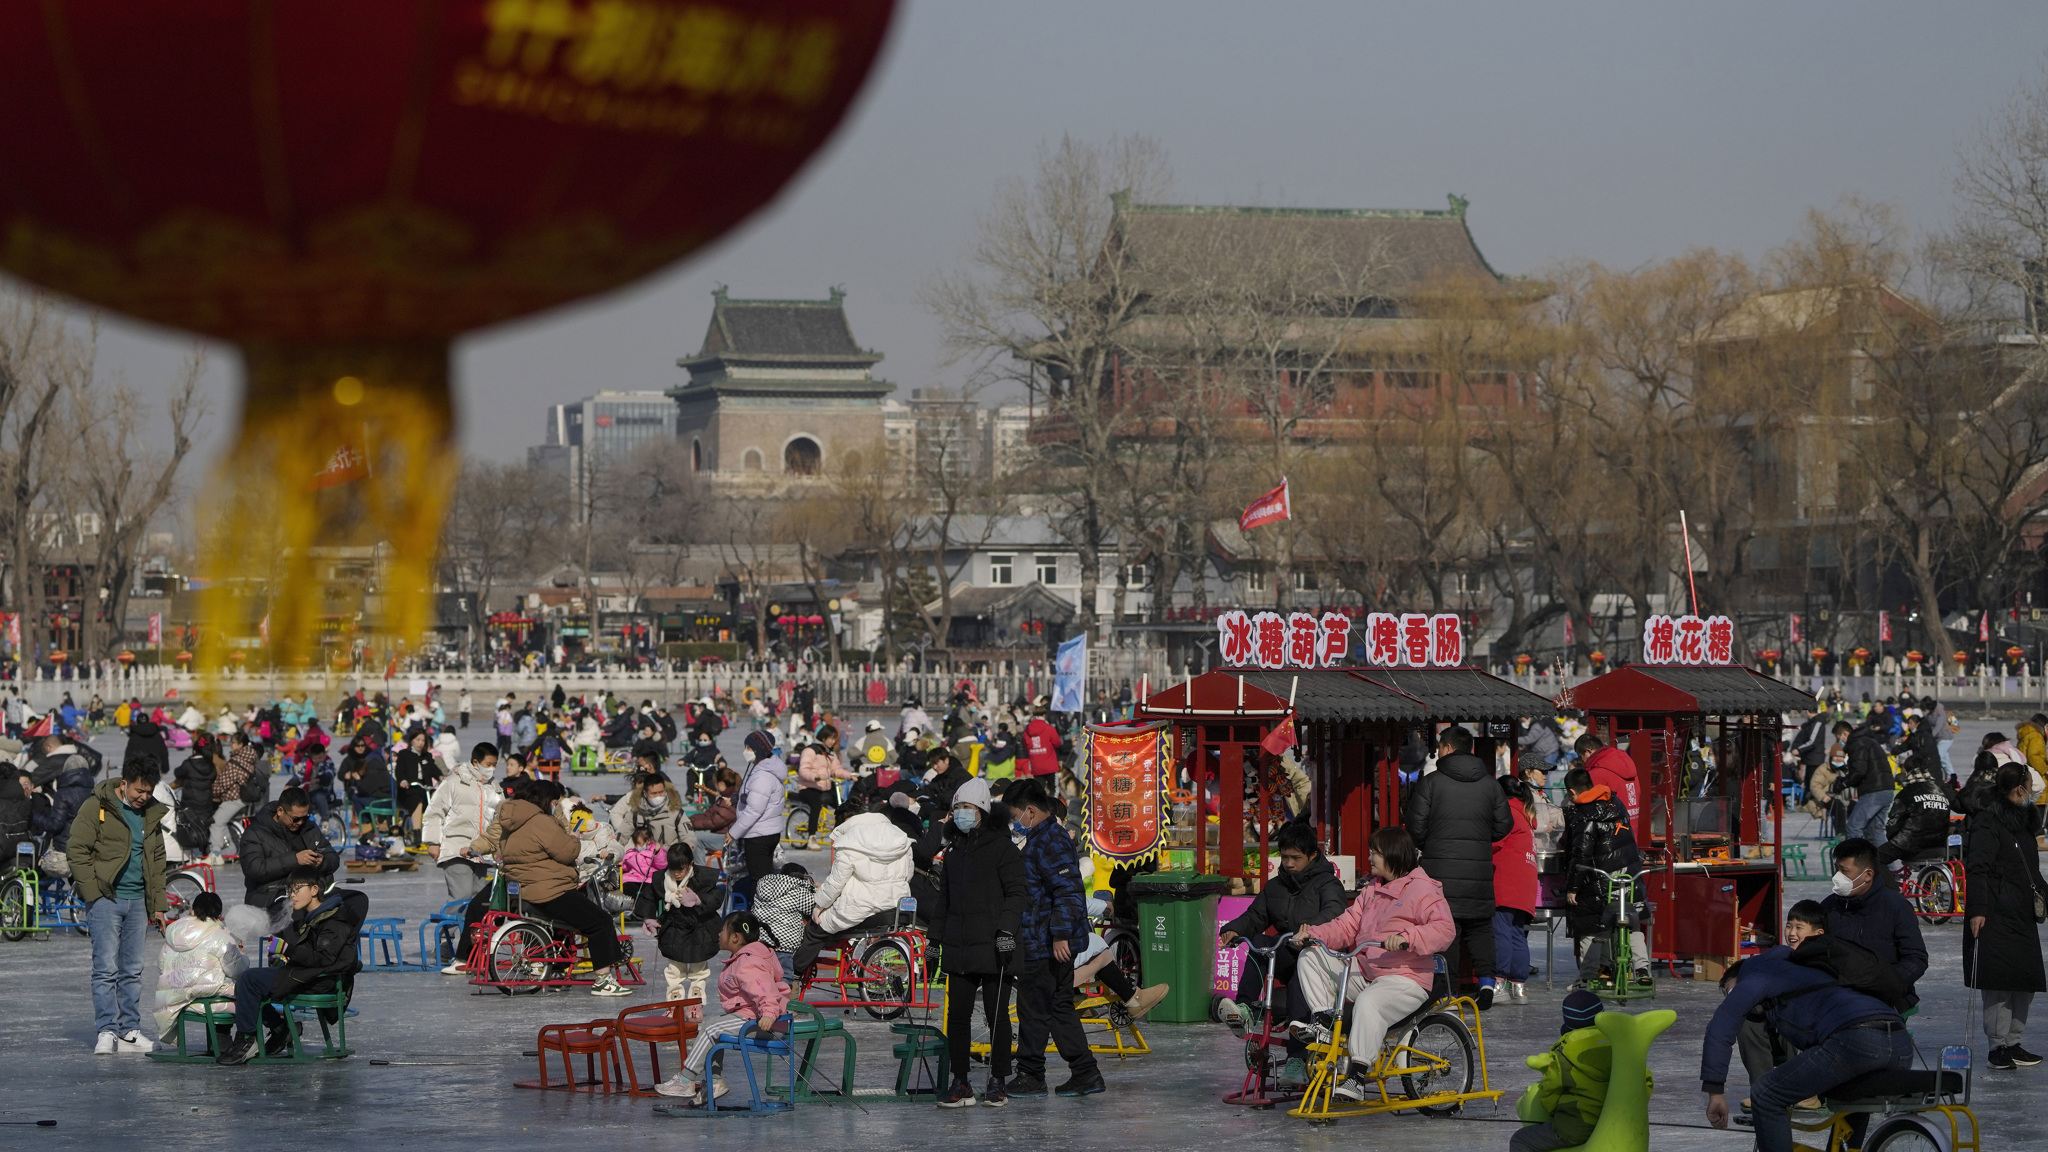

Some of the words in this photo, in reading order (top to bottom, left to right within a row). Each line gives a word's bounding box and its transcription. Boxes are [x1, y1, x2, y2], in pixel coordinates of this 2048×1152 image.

[1224, 614, 1349, 666] 冰糖葫芦
[1372, 616, 1461, 665] 烤香肠
[1650, 618, 1732, 661] 棉花糖
[1111, 752, 1134, 846] 冰糖葫芦
[1143, 759, 1154, 832] 童年的回忆
[1923, 801, 1948, 810] PEOPLE
[1217, 949, 1230, 977] 立减
[1216, 980, 1229, 990] 20
